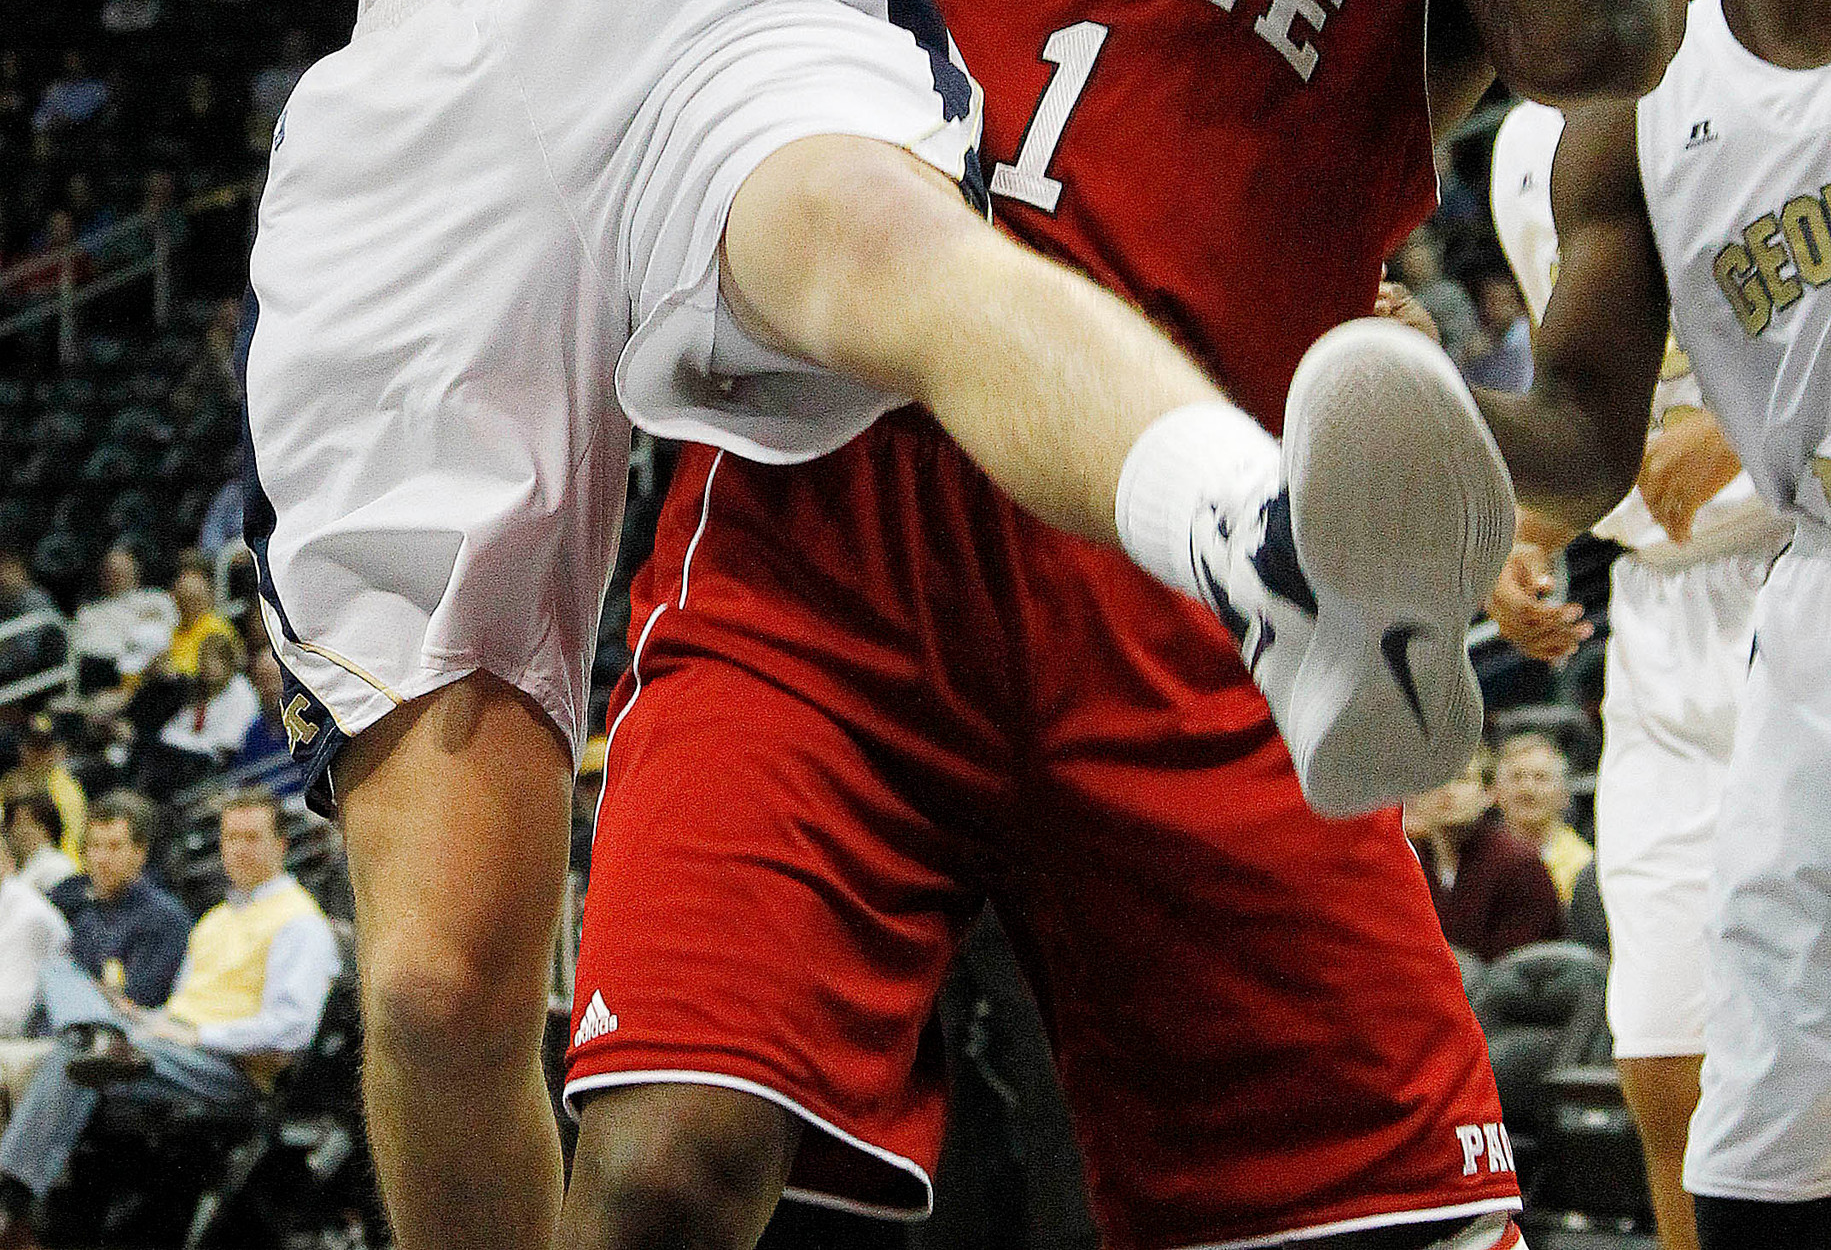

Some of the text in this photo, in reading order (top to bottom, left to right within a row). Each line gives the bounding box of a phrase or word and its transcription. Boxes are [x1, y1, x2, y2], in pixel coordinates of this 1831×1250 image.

[989, 20, 1109, 214] 1
[1713, 183, 1831, 337] GEO
[1455, 1122, 1516, 1177] PA
